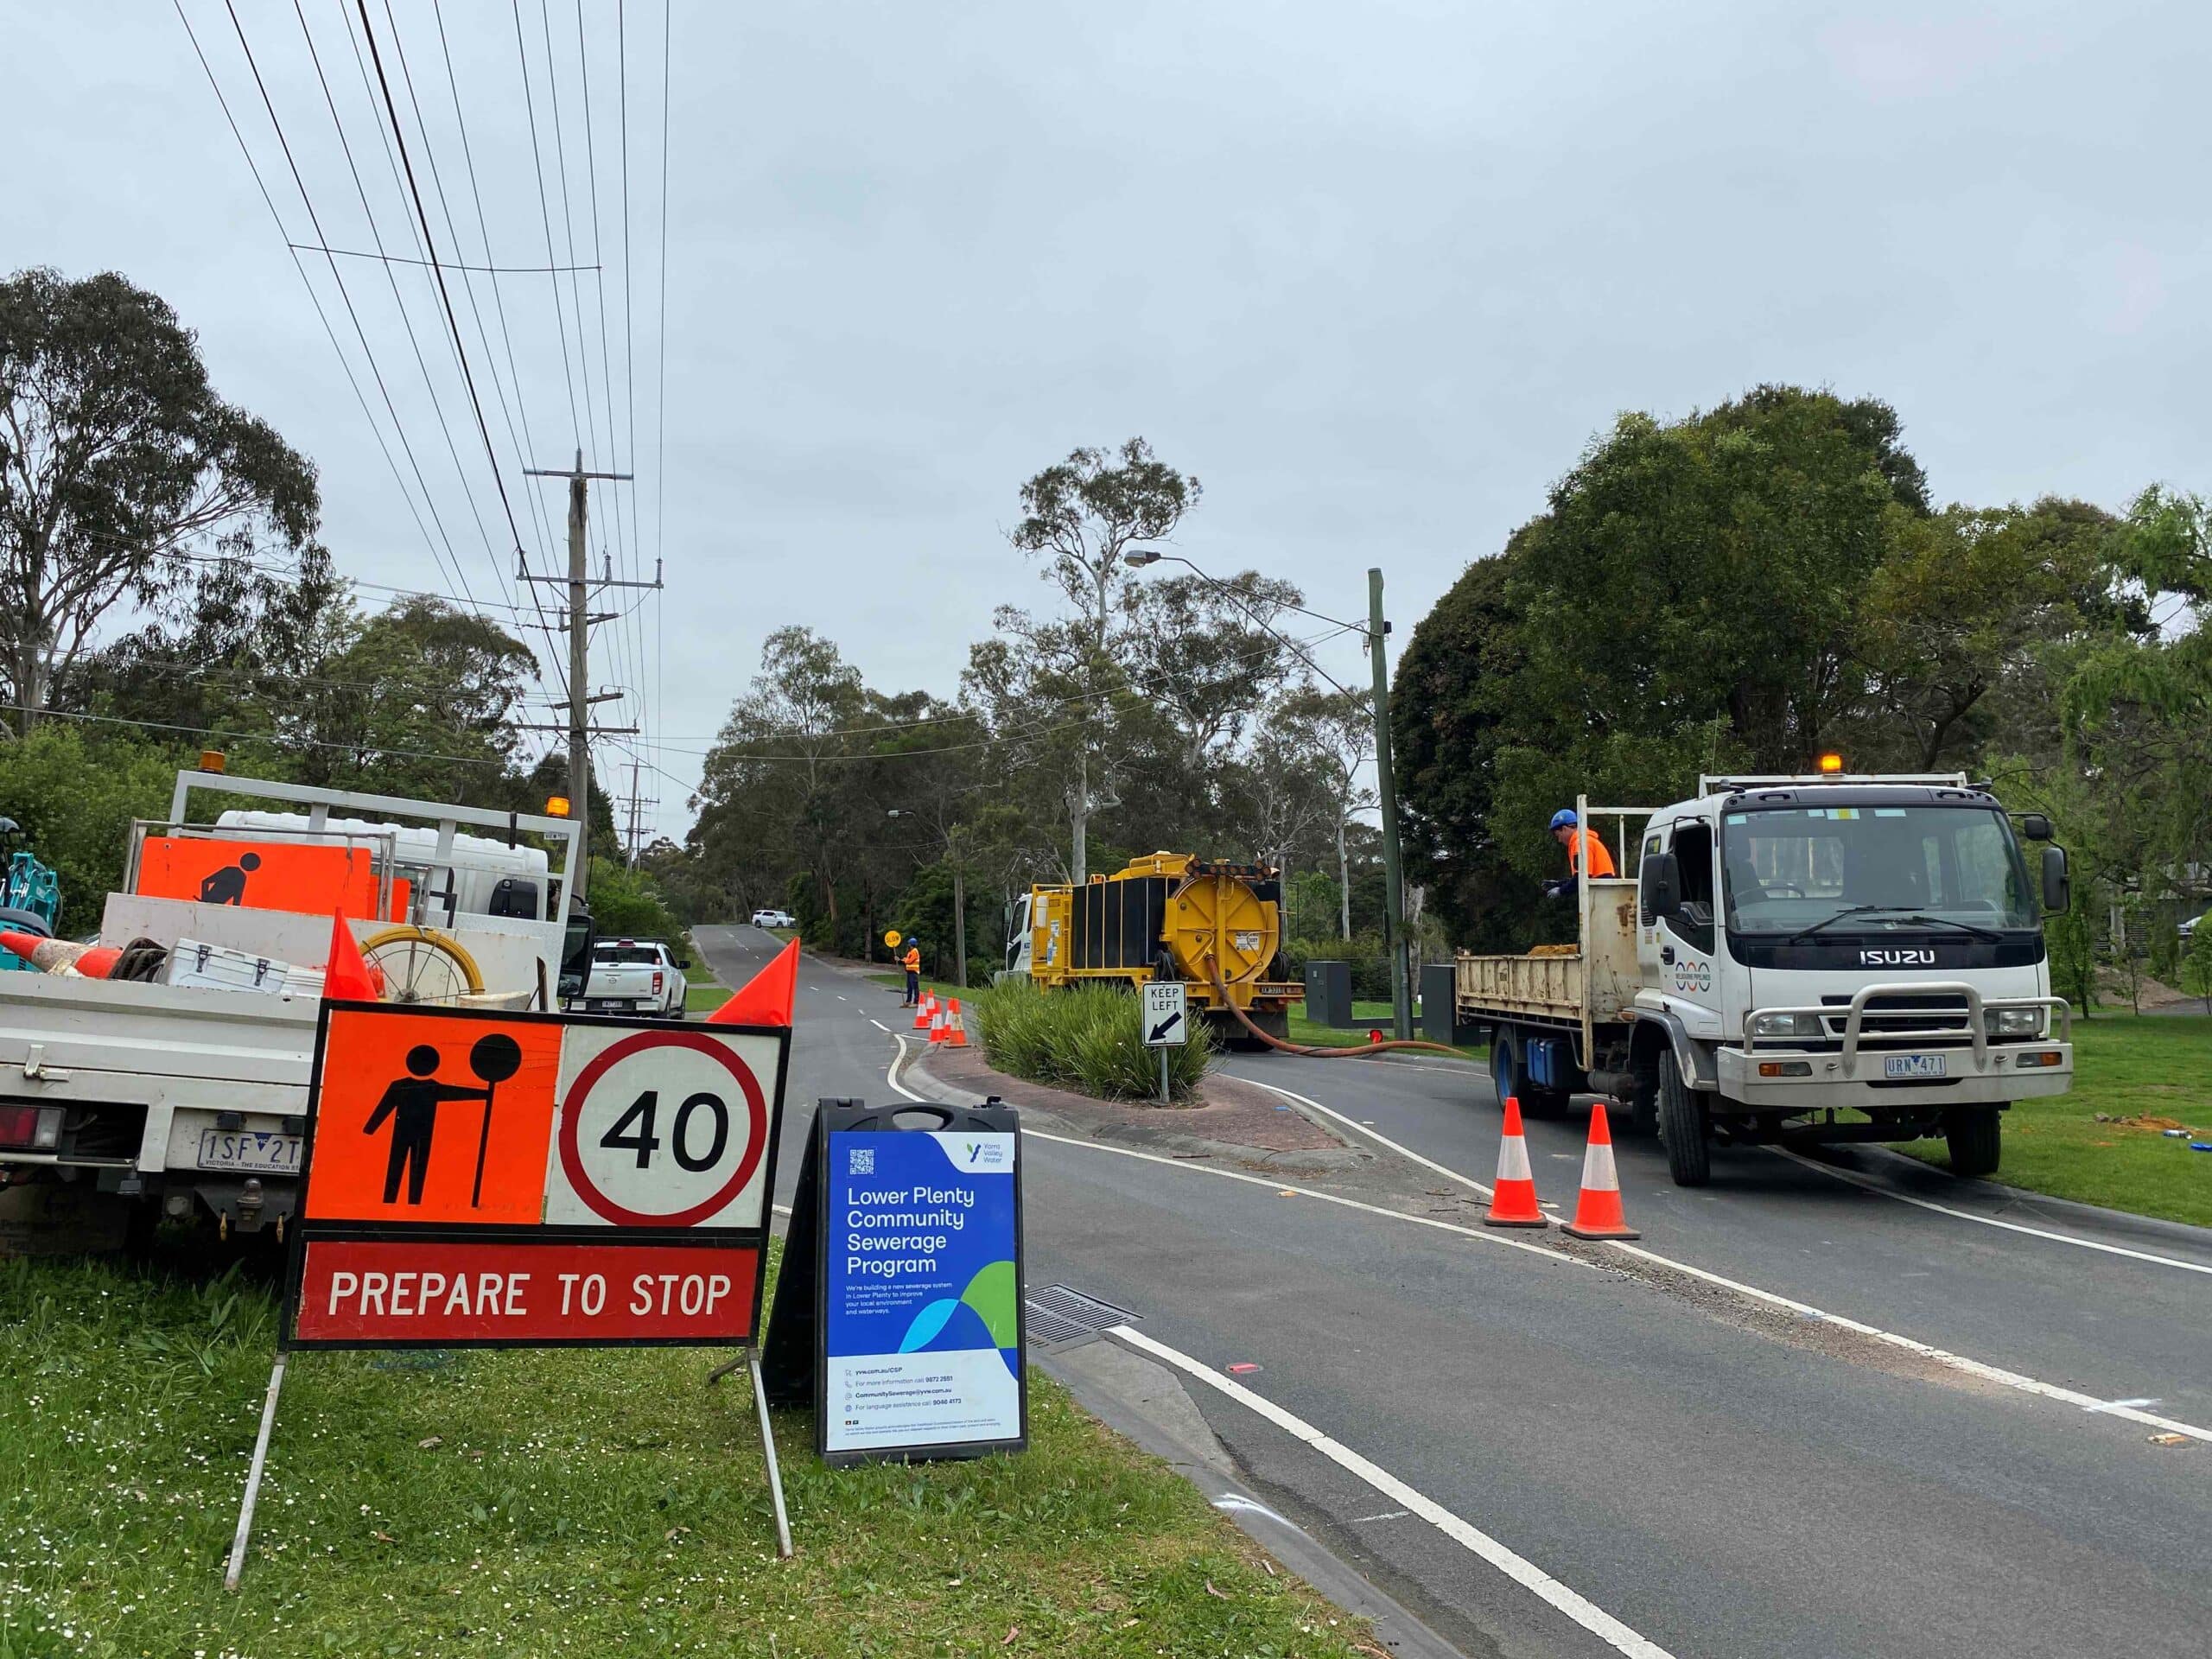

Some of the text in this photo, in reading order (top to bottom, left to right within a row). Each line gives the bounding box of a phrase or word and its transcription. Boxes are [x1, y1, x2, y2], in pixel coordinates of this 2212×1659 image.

[1859, 950, 1936, 965] ISUZU
[1151, 988, 1179, 998] KEEP
[1152, 1001, 1178, 1010] LEFT
[1888, 1058, 1942, 1072] URN 471
[600, 1090, 730, 1173] 40
[209, 1135, 252, 1160] 1SF
[984, 1149, 1003, 1158] Valley
[254, 1162, 290, 1171] EDUCATION
[848, 1186, 975, 1207] Lower Plenty
[847, 1209, 964, 1230] Community
[847, 1233, 947, 1254] Sewerage
[847, 1256, 937, 1278] Program
[327, 1272, 732, 1317] PREPARE TO STOP
[855, 1367, 903, 1376] yvw.com.au/CSP
[855, 1388, 952, 1399] CommunitySewerage@yvw.com.au
